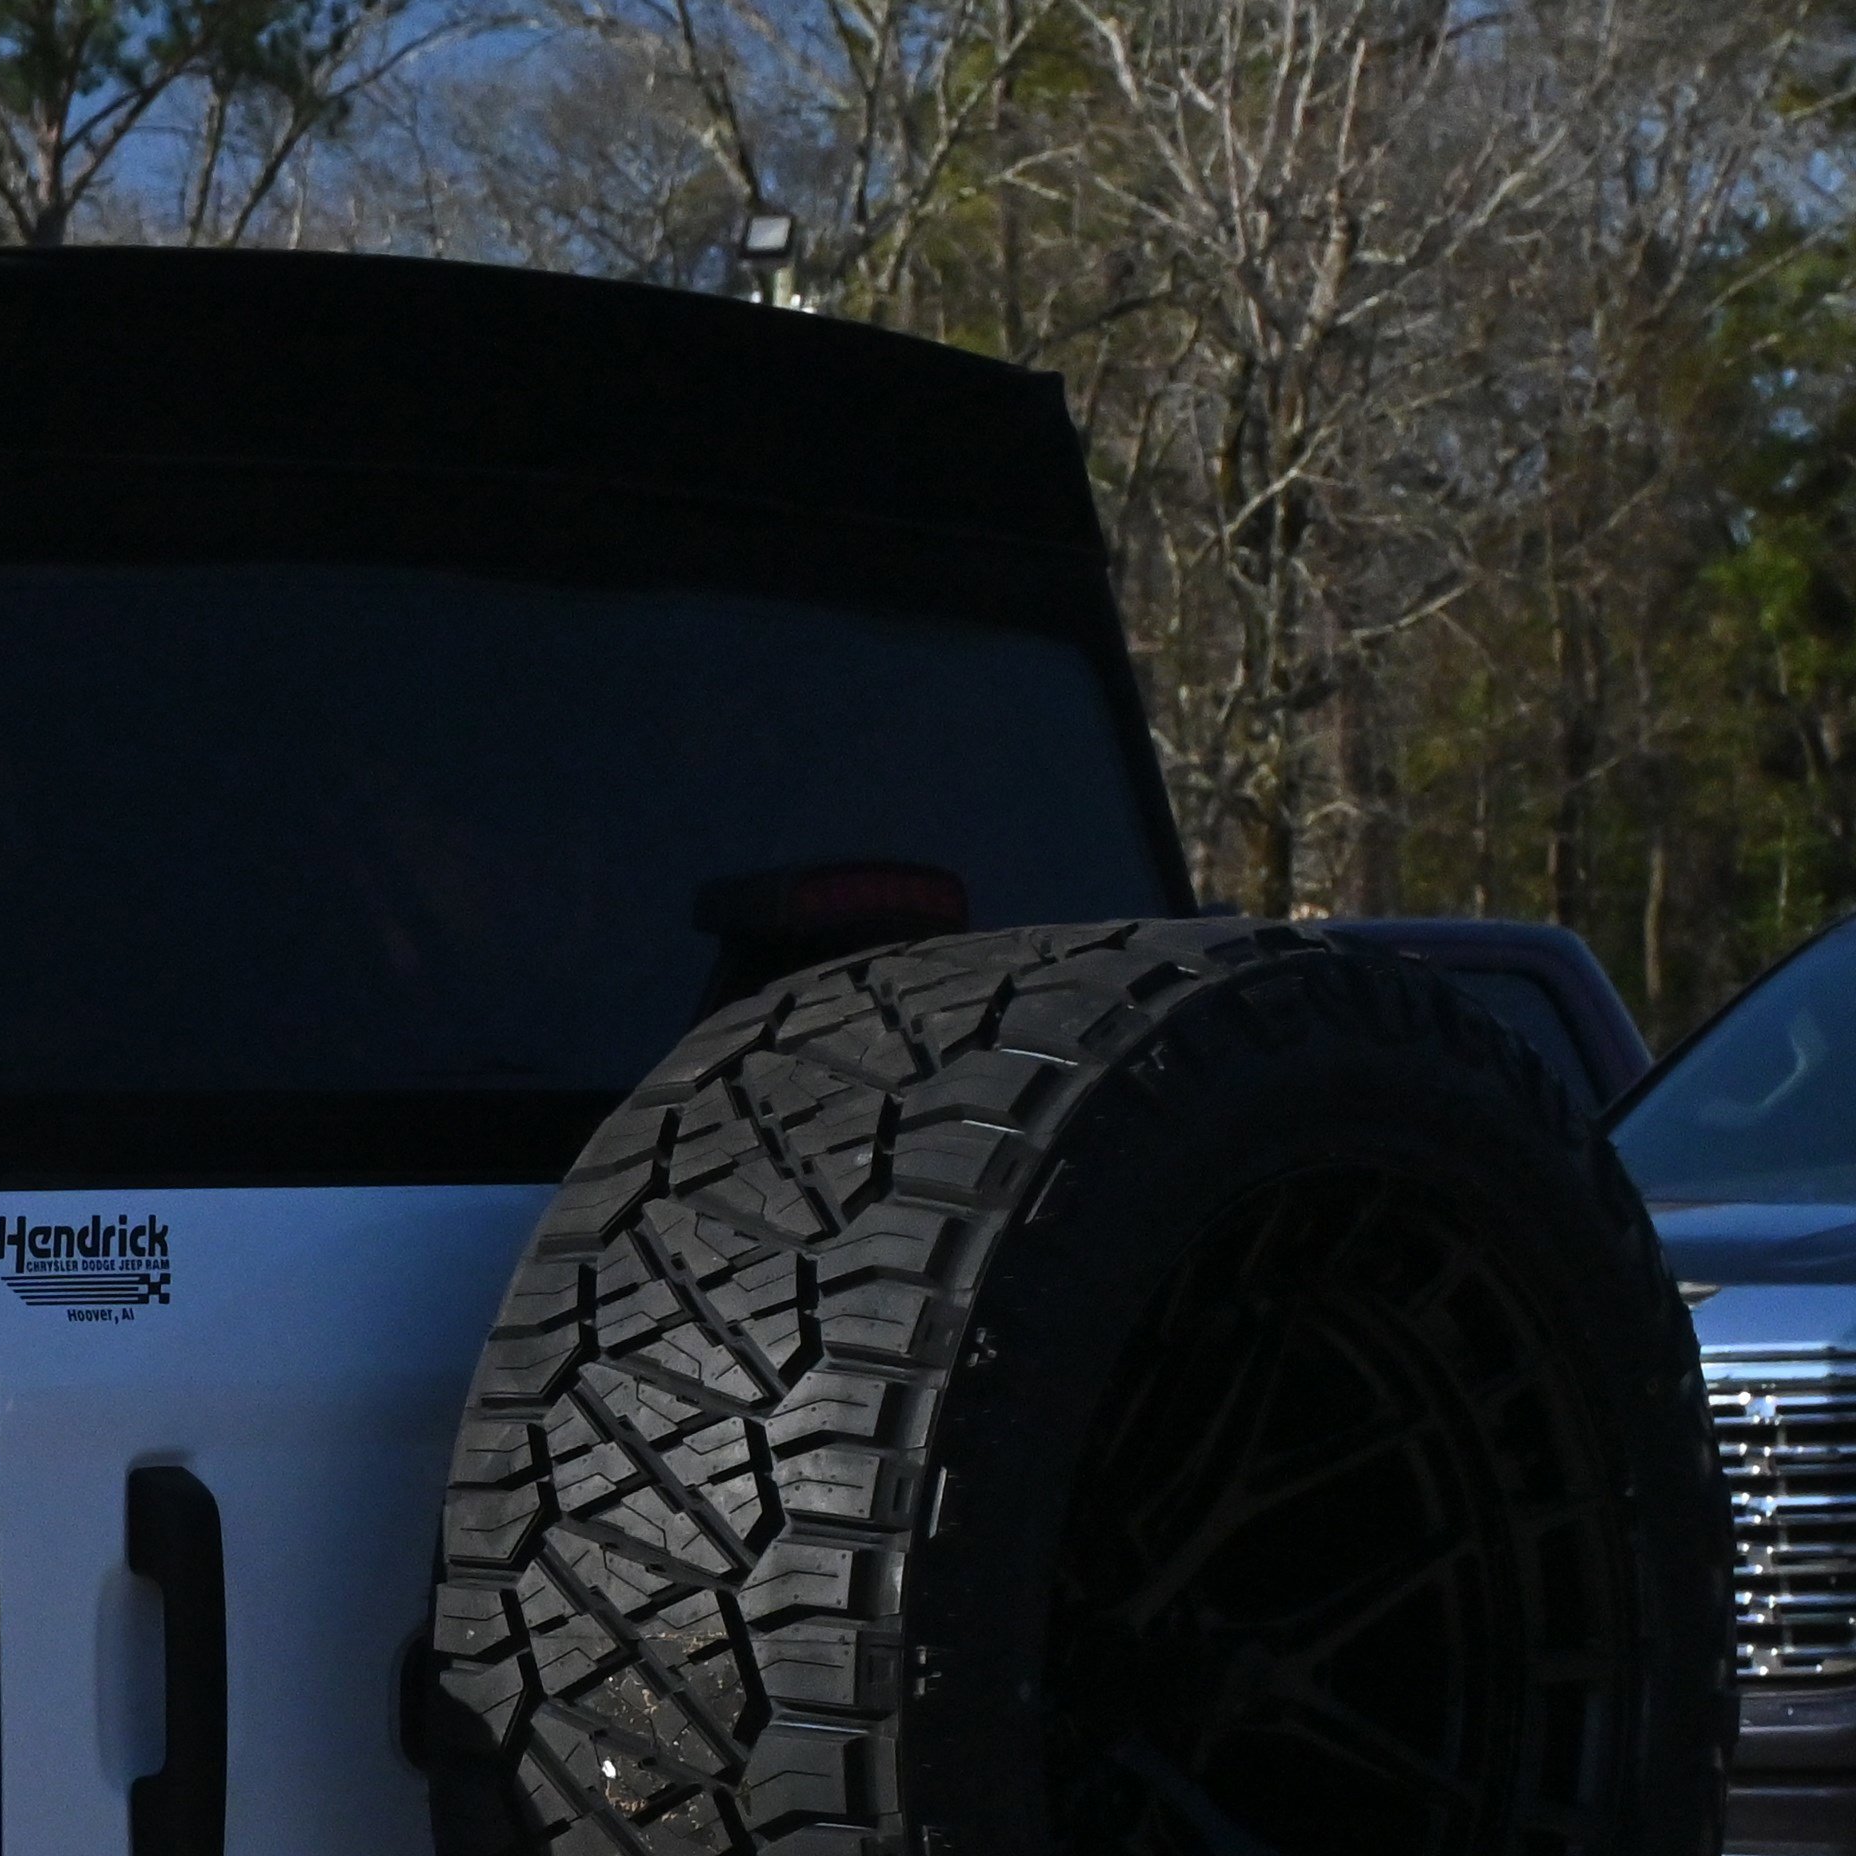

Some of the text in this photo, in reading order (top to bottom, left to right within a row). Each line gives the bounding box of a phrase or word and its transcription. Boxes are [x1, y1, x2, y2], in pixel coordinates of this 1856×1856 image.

[26, 1259, 170, 1272] CHRYSLER DODGE JEEP RAM
[67, 1308, 119, 1324] Hoover,
